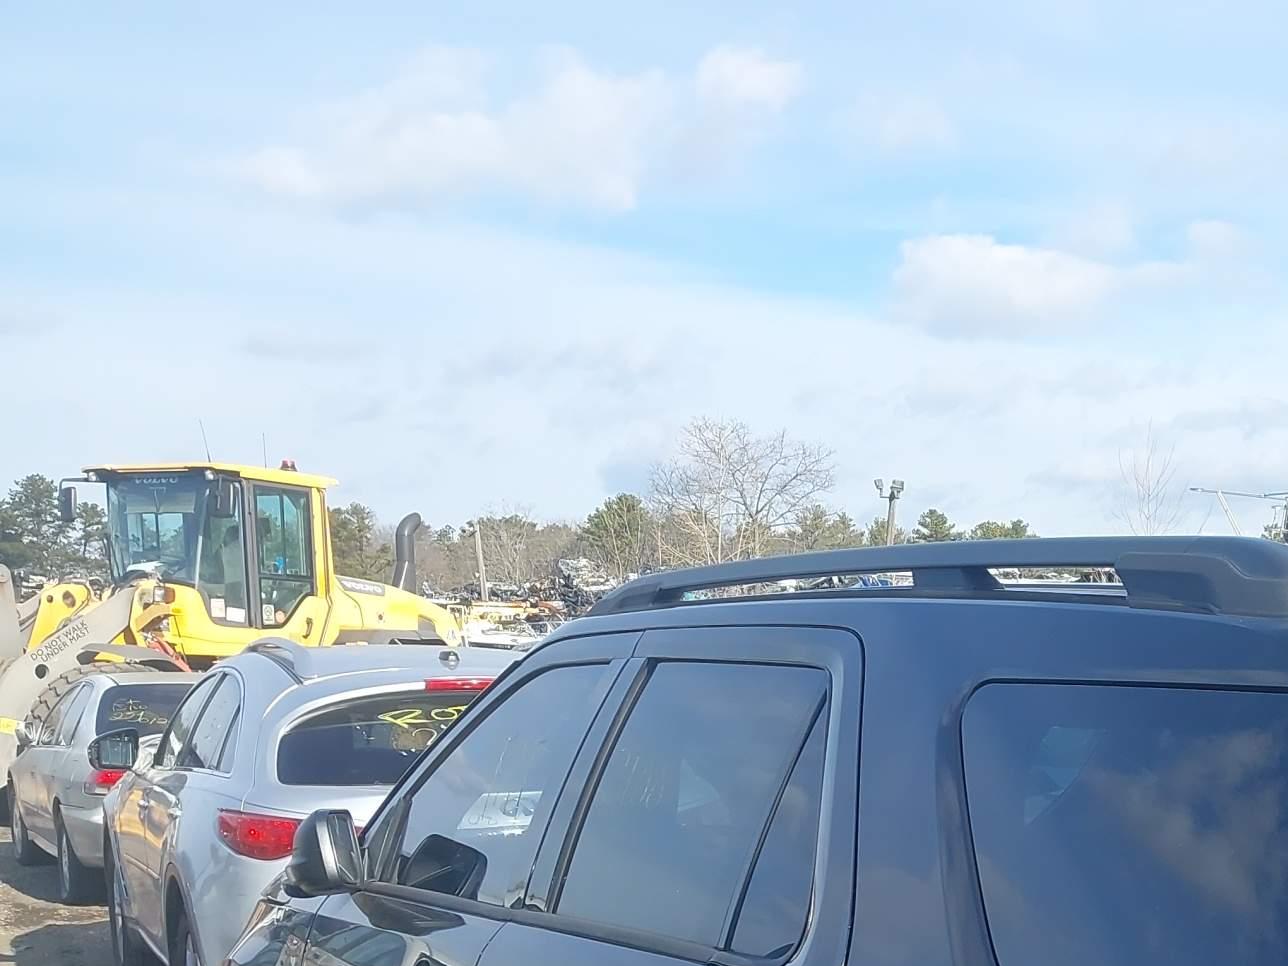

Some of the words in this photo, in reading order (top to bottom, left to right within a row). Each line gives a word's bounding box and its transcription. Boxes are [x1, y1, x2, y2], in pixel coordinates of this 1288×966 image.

[30, 648, 44, 661] DO
[44, 635, 63, 652] NOT
[62, 619, 88, 639] WALK
[40, 641, 70, 663] UNDER
[68, 626, 90, 644] MAST
